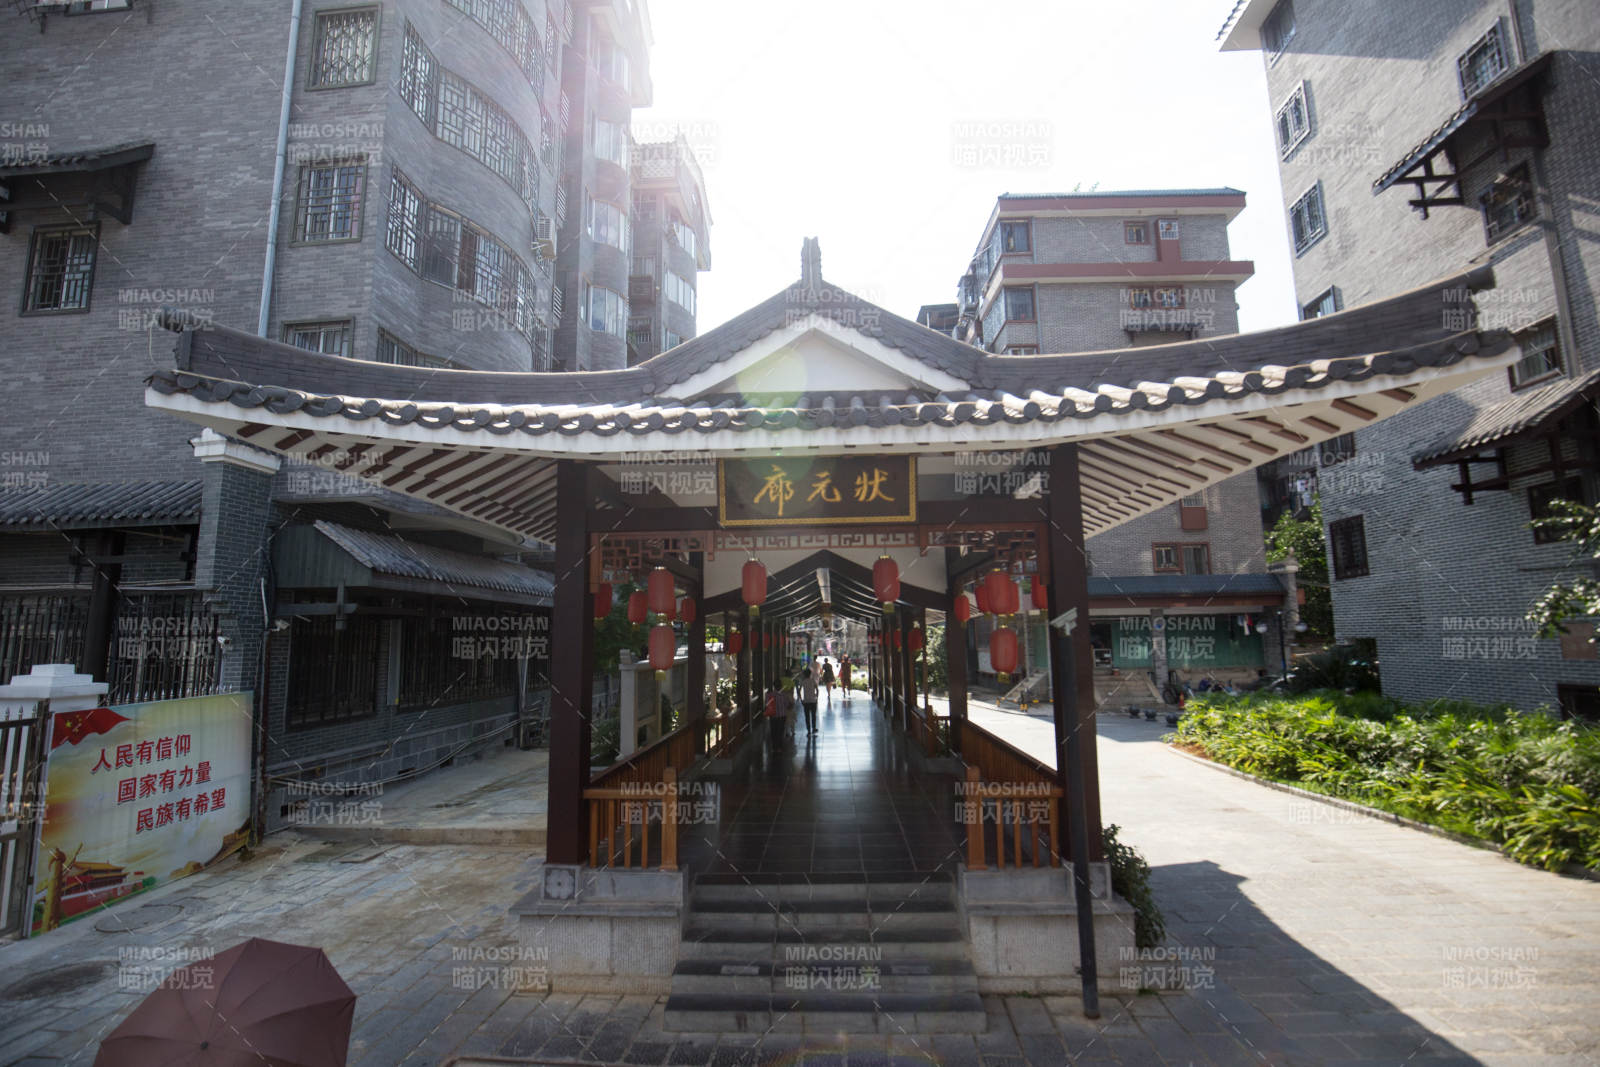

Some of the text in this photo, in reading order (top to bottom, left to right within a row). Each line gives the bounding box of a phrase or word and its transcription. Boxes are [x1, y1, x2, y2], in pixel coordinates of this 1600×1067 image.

[91, 734, 191, 773] 人民有信仰
[117, 761, 211, 804] 国家有力量
[136, 787, 226, 833] 民族有希望
